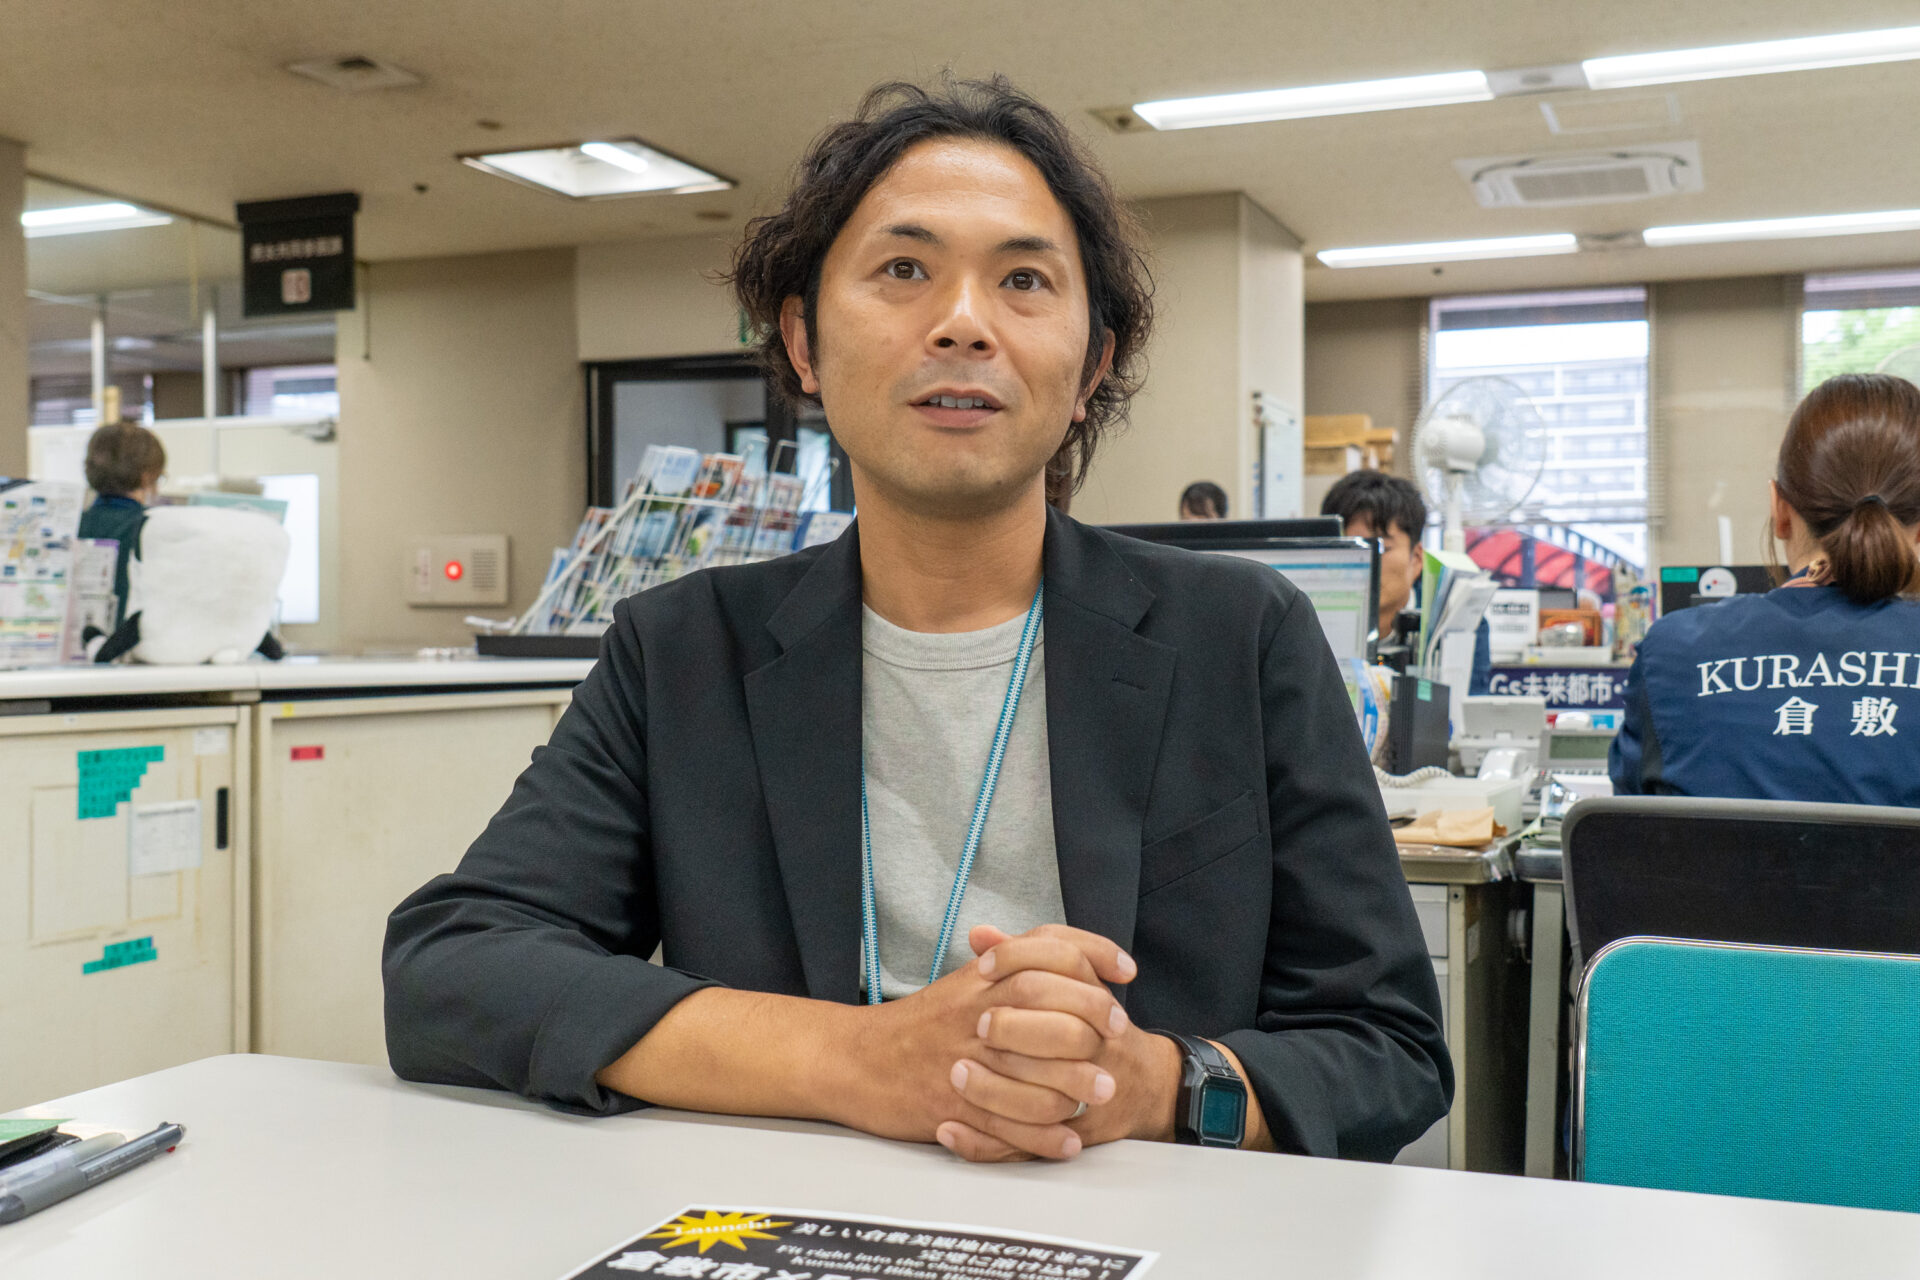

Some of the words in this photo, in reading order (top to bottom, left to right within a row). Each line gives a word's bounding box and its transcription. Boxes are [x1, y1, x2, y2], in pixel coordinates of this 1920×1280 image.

[674, 1218, 771, 1236] Launch!
[790, 1255, 882, 1274] Kurashiki
[805, 1248, 852, 1261] right
[854, 1252, 892, 1264] into
[895, 1257, 925, 1268] the
